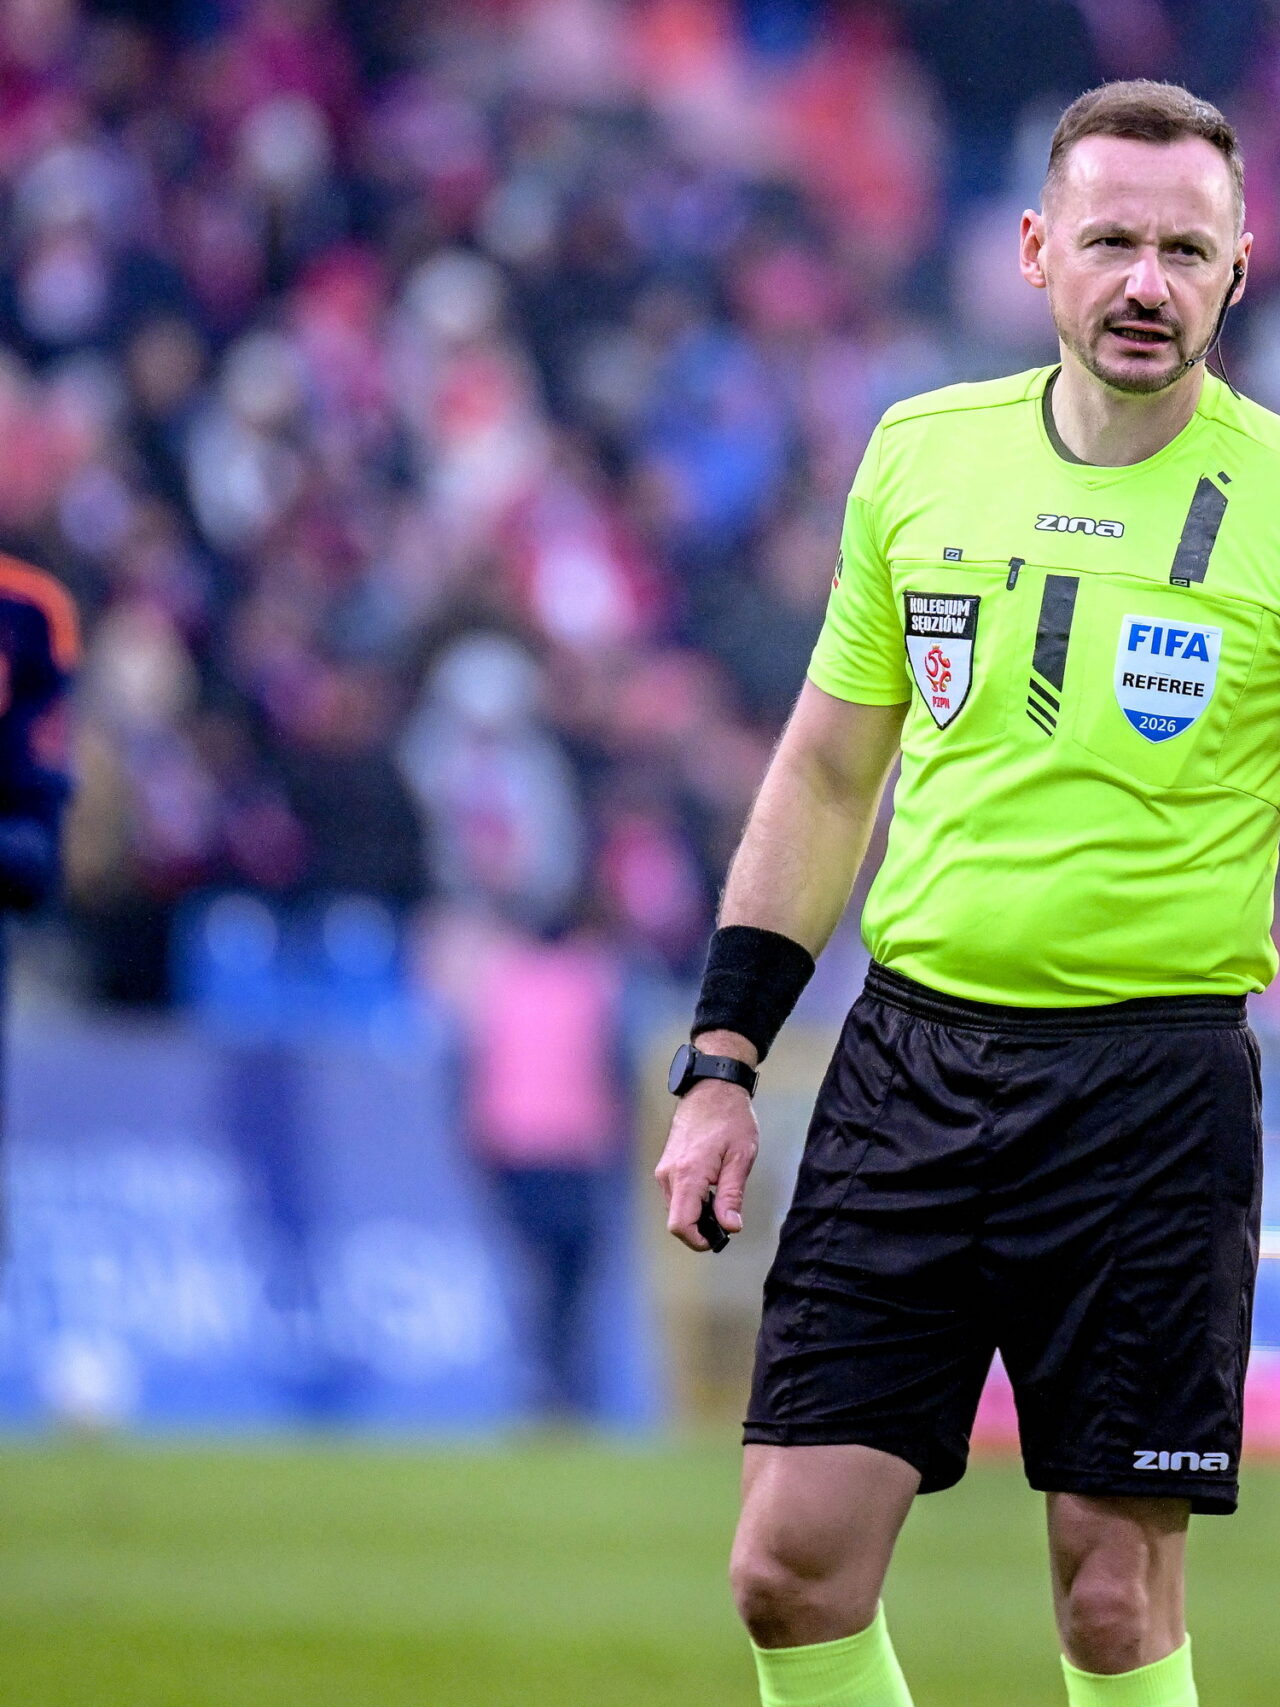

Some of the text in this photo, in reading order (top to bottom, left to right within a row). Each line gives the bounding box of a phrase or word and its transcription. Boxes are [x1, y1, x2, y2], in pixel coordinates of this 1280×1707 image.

[909, 597, 970, 617] KOLEGIUM
[911, 614, 967, 634] SĘDZIÓW
[1127, 623, 1210, 662] FIFA
[1122, 672, 1205, 697] REFEREE
[932, 696, 951, 709] PZPN
[1138, 715, 1177, 732] 2026
